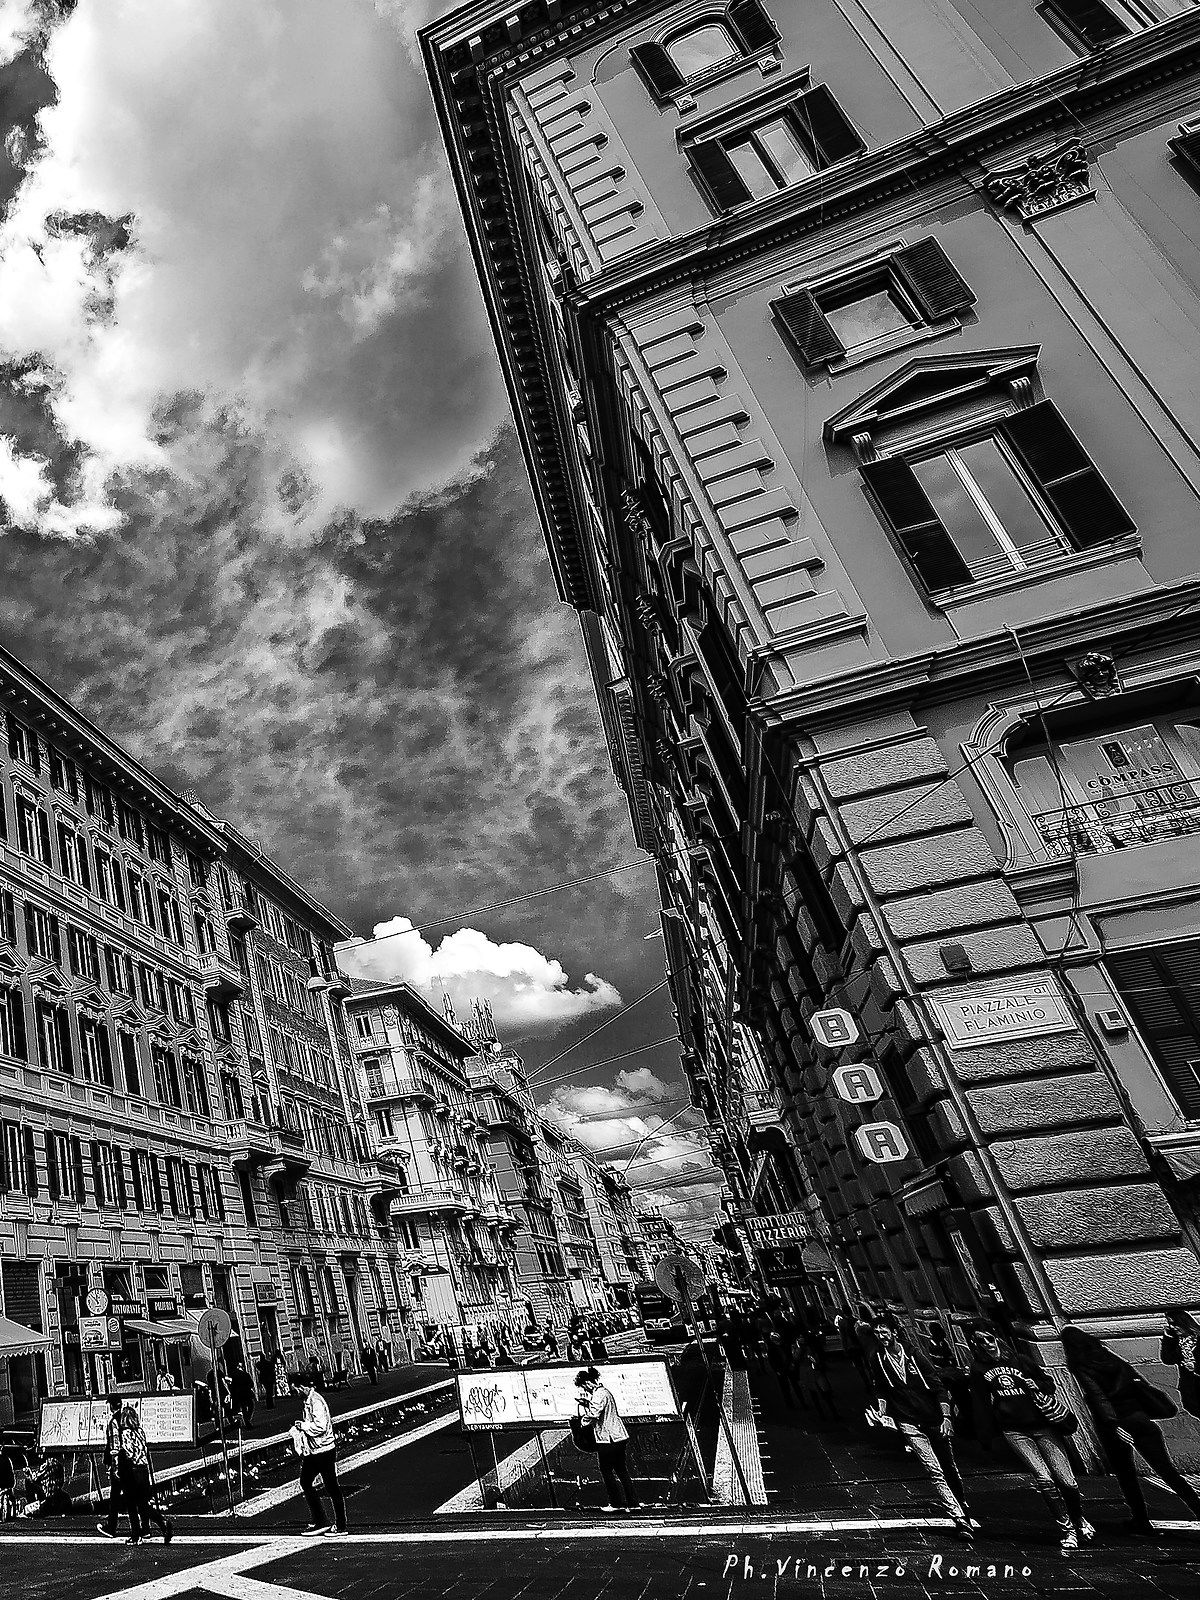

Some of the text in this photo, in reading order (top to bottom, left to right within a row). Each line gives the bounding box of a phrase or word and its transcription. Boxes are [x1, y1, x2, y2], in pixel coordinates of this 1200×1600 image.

[1087, 763, 1173, 789] COMPASS
[960, 995, 1036, 1016] PIAZZALE
[964, 1008, 1046, 1031] FLAMINIO
[754, 1225, 808, 1242] PIZZERIA
[997, 1387, 1026, 1397] ROMA
